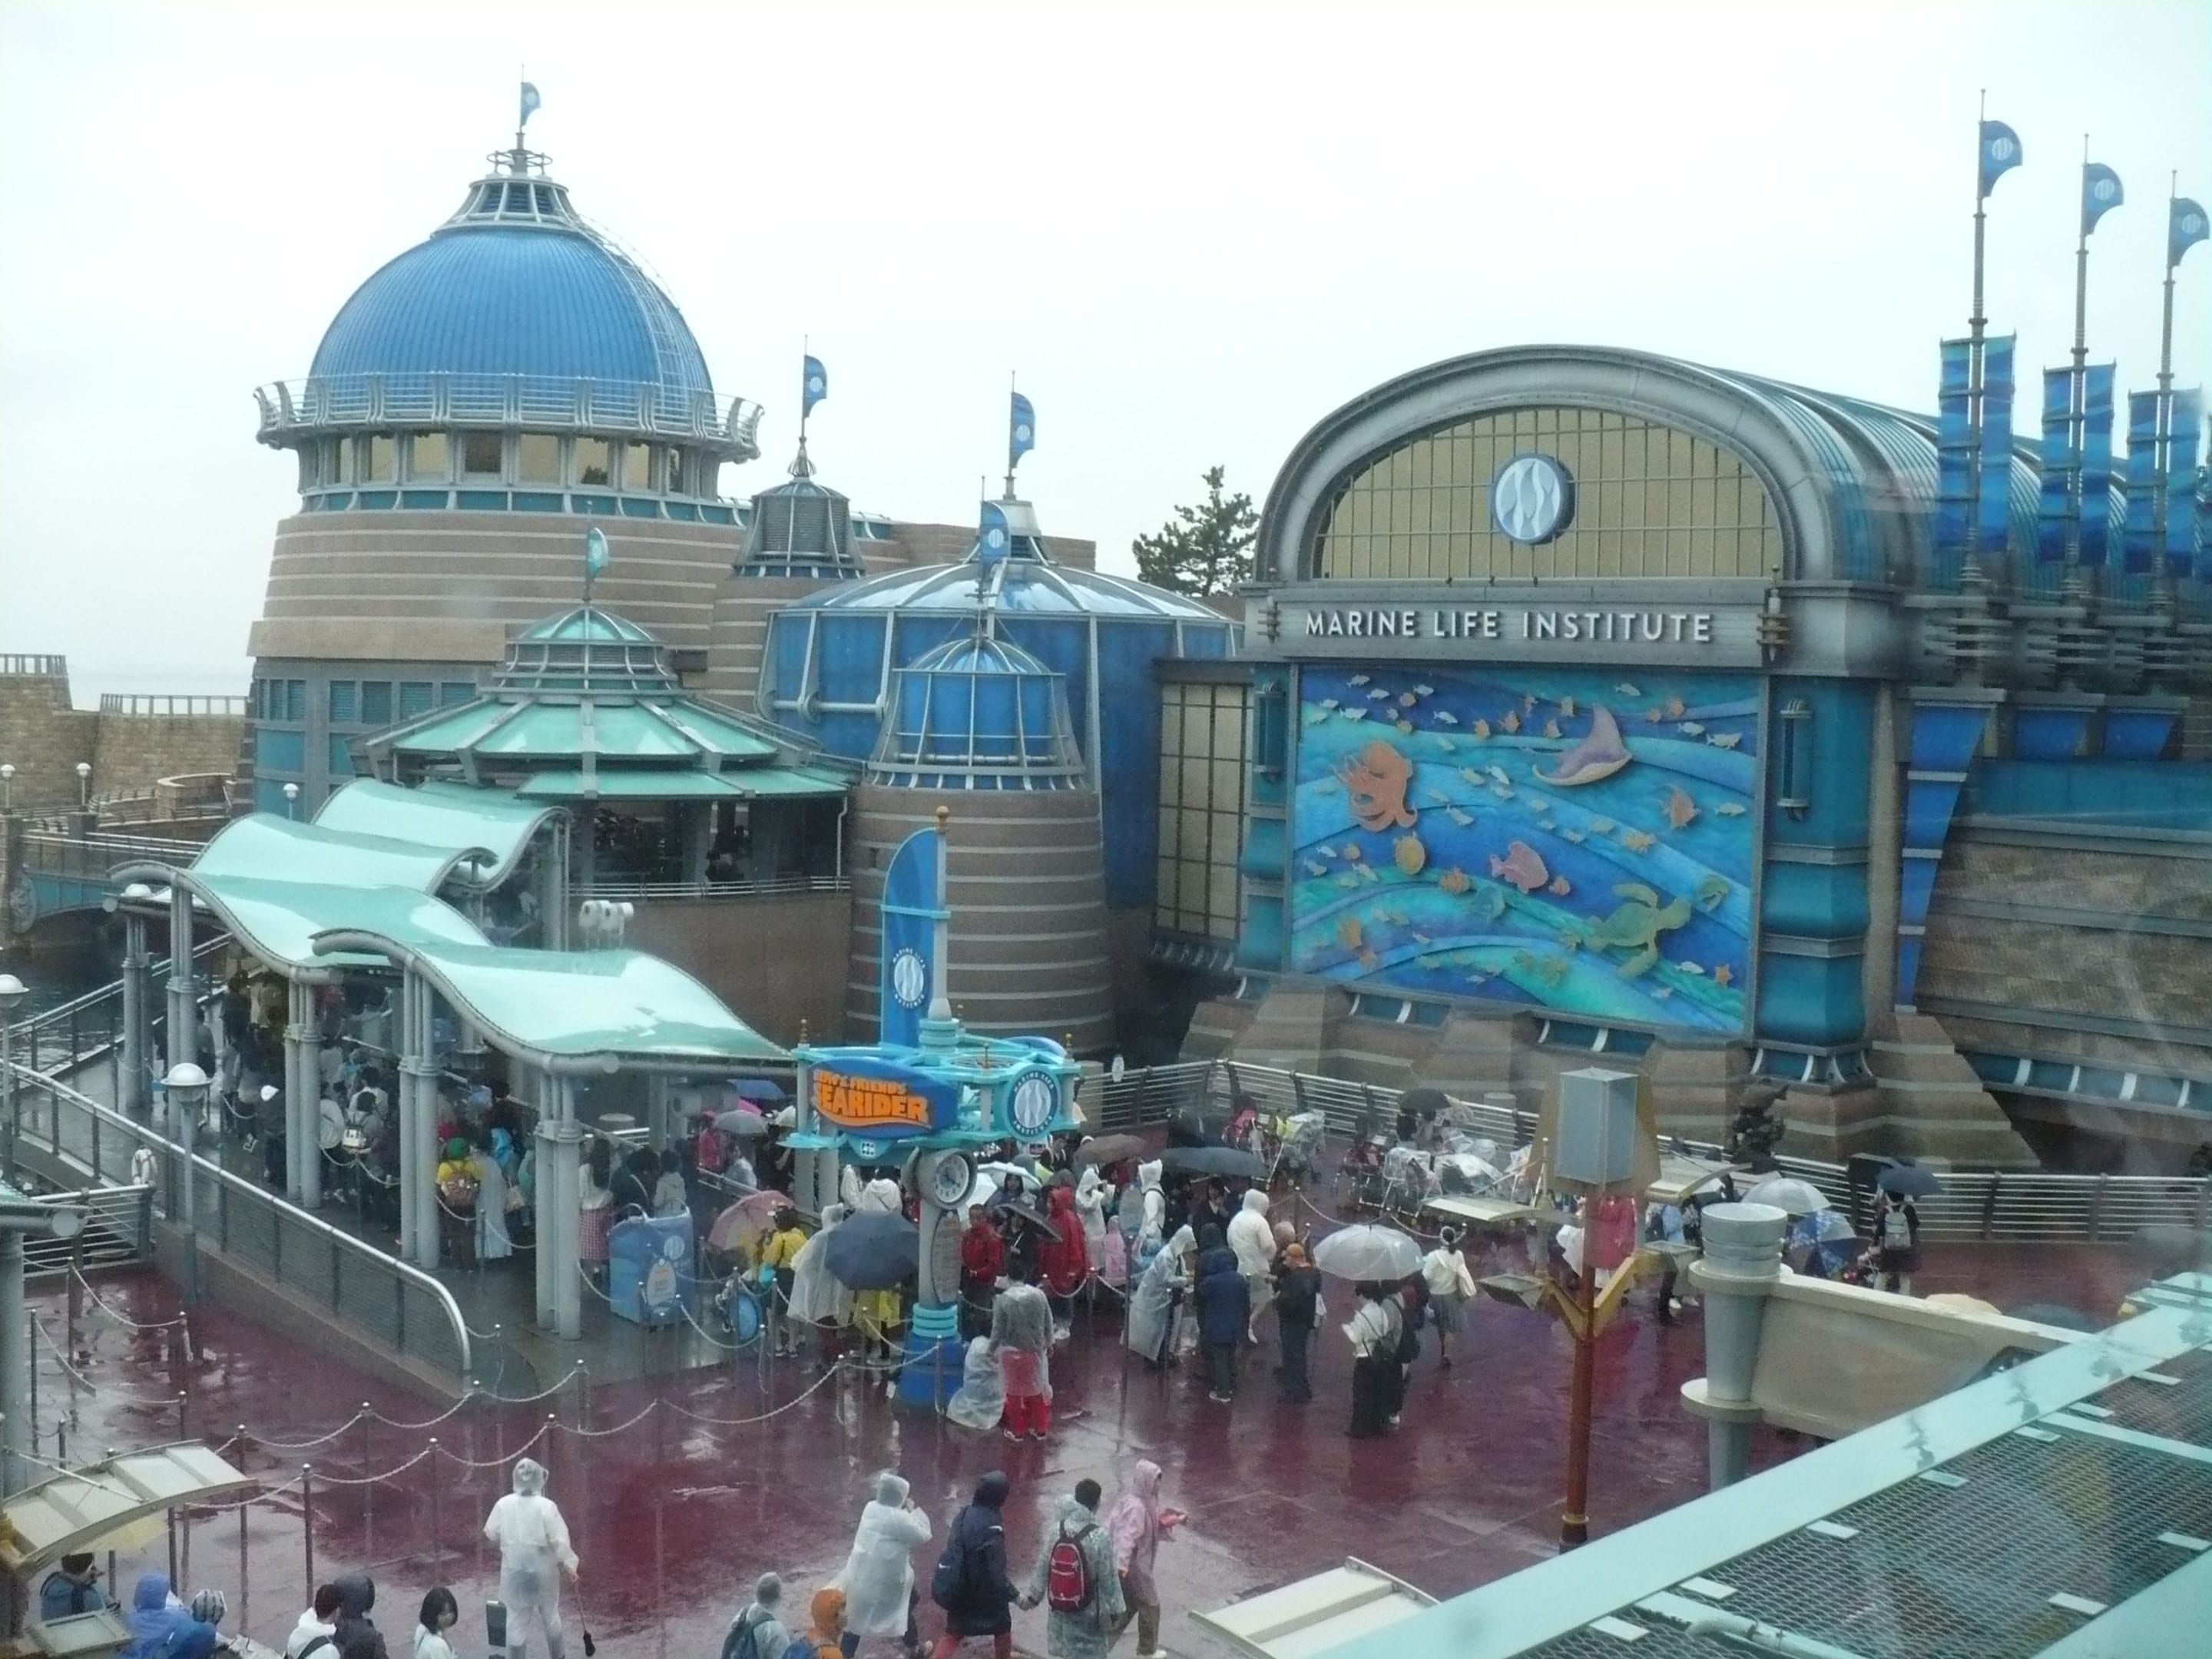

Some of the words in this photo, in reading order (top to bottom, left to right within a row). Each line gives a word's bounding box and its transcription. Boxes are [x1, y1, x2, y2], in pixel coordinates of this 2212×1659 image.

[1306, 611, 1416, 636] MARINE
[1433, 611, 1498, 638] LIFE
[1522, 611, 1711, 642] INSTITUTE
[849, 1076, 909, 1096] FRIENDS
